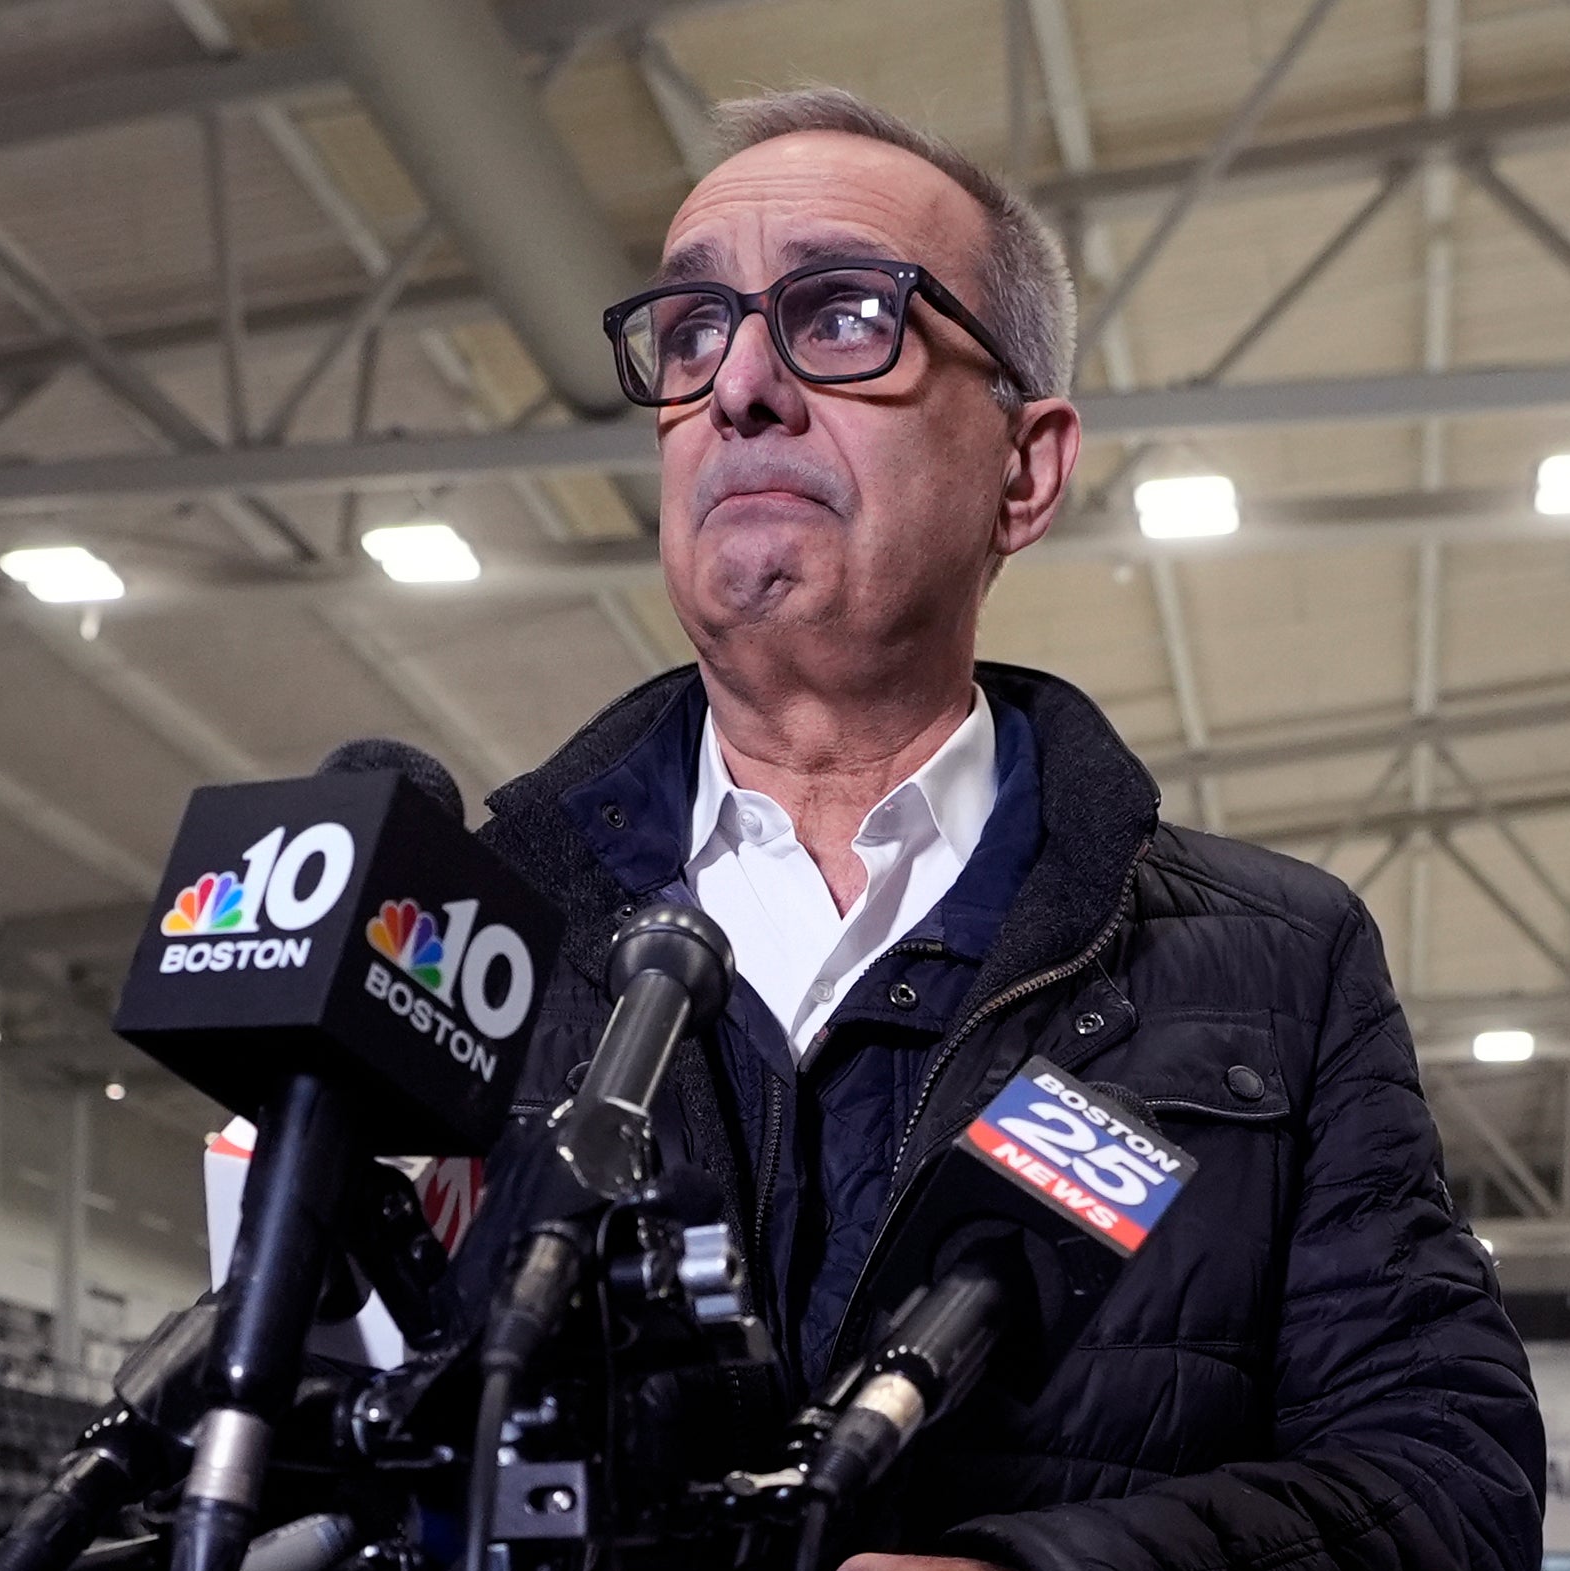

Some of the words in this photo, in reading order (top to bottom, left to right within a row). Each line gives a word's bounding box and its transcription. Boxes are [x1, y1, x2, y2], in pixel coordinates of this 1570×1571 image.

[241, 821, 356, 932] 10
[159, 938, 312, 974] BOSTON
[439, 899, 535, 1041] 10
[364, 962, 498, 1084] BOSTON
[997, 1102, 1166, 1206] 25
[1032, 1072, 1181, 1173] BOSTON
[991, 1142, 1119, 1230] NEWS
